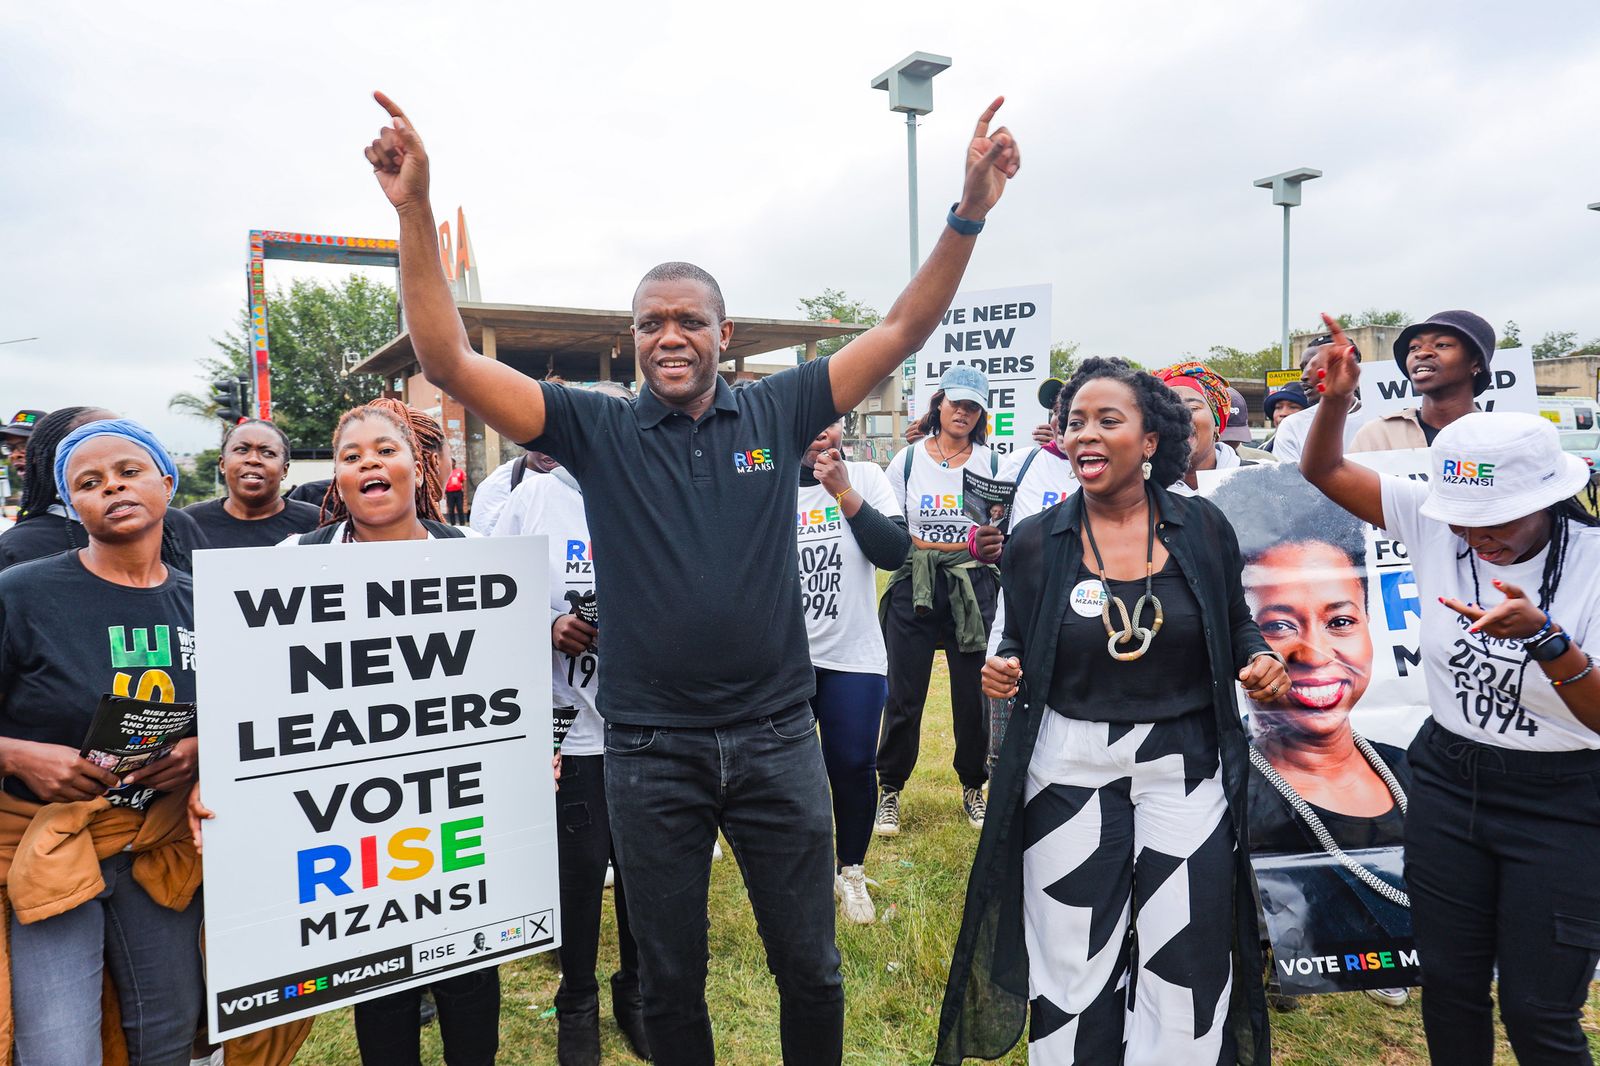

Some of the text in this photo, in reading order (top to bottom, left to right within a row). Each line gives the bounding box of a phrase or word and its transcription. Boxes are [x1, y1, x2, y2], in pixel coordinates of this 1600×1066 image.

[973, 302, 1036, 322] NEED
[944, 327, 1016, 353] NEW
[926, 355, 1034, 378] LEDERS
[988, 388, 1015, 408] TE
[733, 448, 772, 467] RISE
[737, 462, 775, 474] MZANSI
[1443, 459, 1495, 478] RISE
[1443, 475, 1494, 487] MZANSI
[1042, 491, 1067, 506] RI
[798, 521, 841, 536] ZANSI
[1375, 540, 1409, 560] FO
[808, 572, 841, 593] OUR
[234, 574, 518, 628] WE NEED
[1077, 589, 1107, 600] RISE
[803, 593, 839, 620] 994
[289, 629, 476, 694] NEW
[124, 713, 195, 724] SOUTH AFRICA
[142, 709, 167, 717] RISE
[1456, 691, 1538, 737] 1994
[120, 719, 191, 730] AND REGISTER
[121, 727, 136, 735] TO
[238, 688, 521, 762] LEADERS
[125, 741, 163, 750] MZANSI
[293, 762, 484, 834] VOTE
[297, 816, 485, 904] RISE
[300, 879, 487, 947] MZANSI
[501, 927, 521, 938] RISE
[419, 943, 456, 963] RISE
[1279, 955, 1340, 976] VOTE
[1344, 951, 1395, 972] RISE
[220, 957, 406, 1016] VOTE RISE MZANSI
